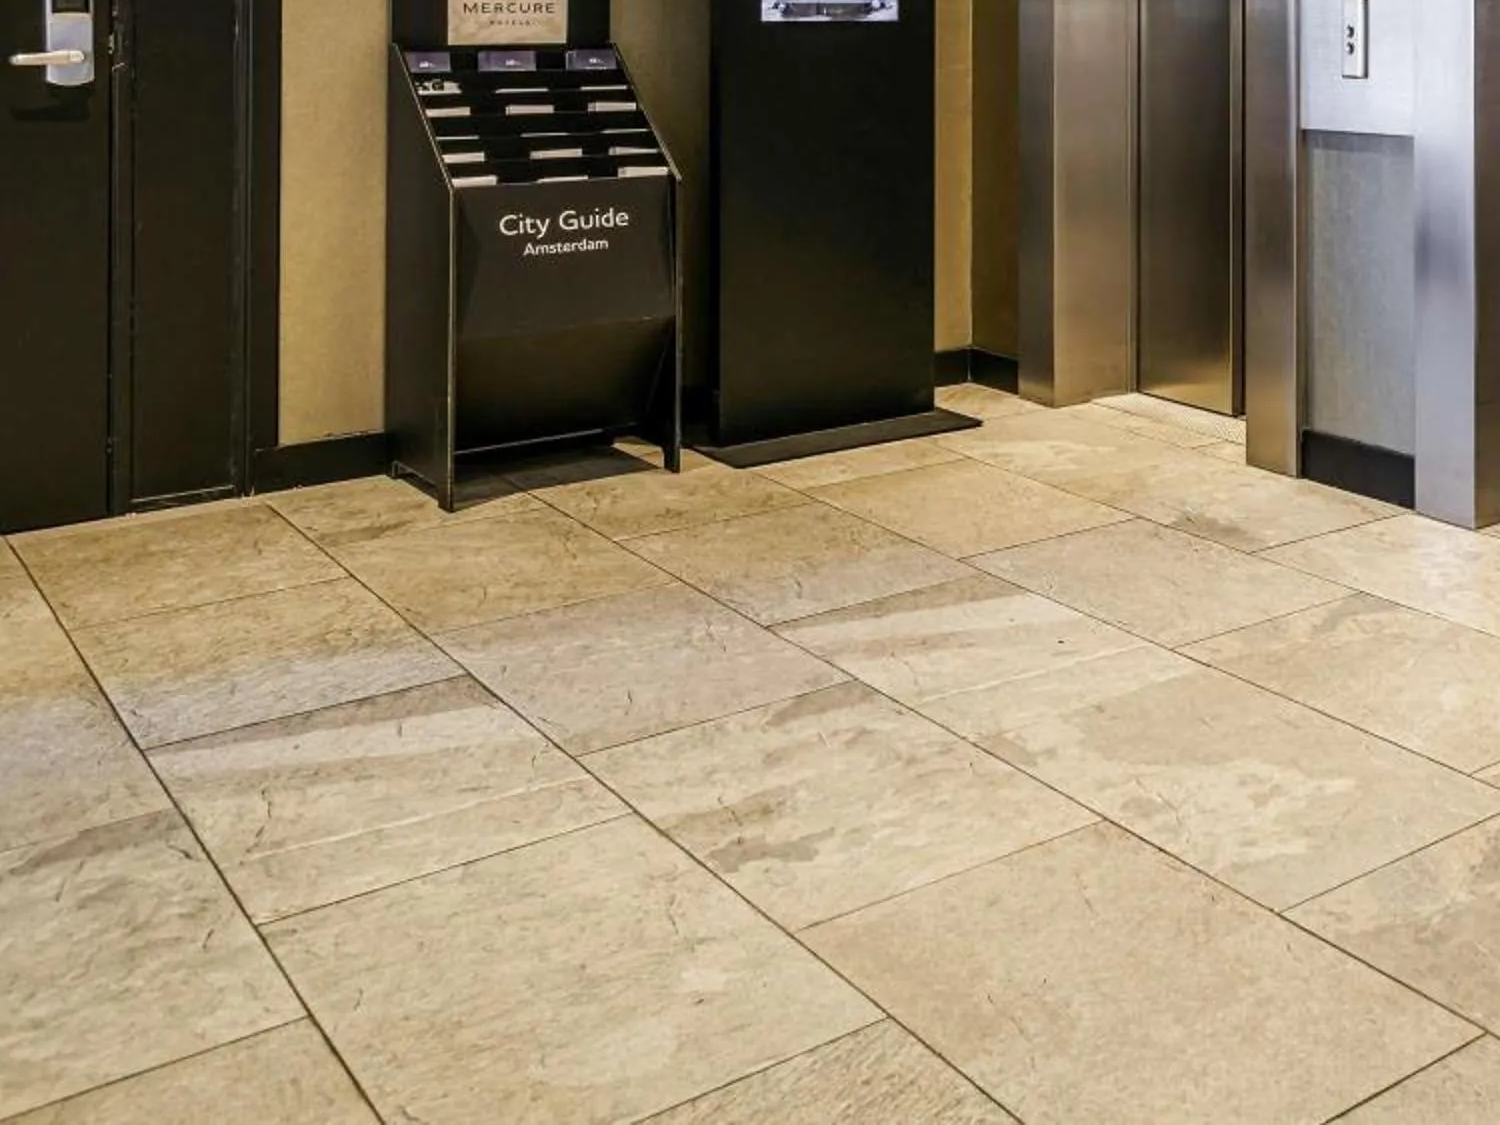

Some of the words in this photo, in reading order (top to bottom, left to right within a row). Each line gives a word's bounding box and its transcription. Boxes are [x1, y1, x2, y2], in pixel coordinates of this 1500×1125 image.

[463, 2, 556, 14] MERCURE
[499, 212, 550, 239] City
[558, 207, 629, 231] Guide
[523, 238, 609, 257] Amsterdam
